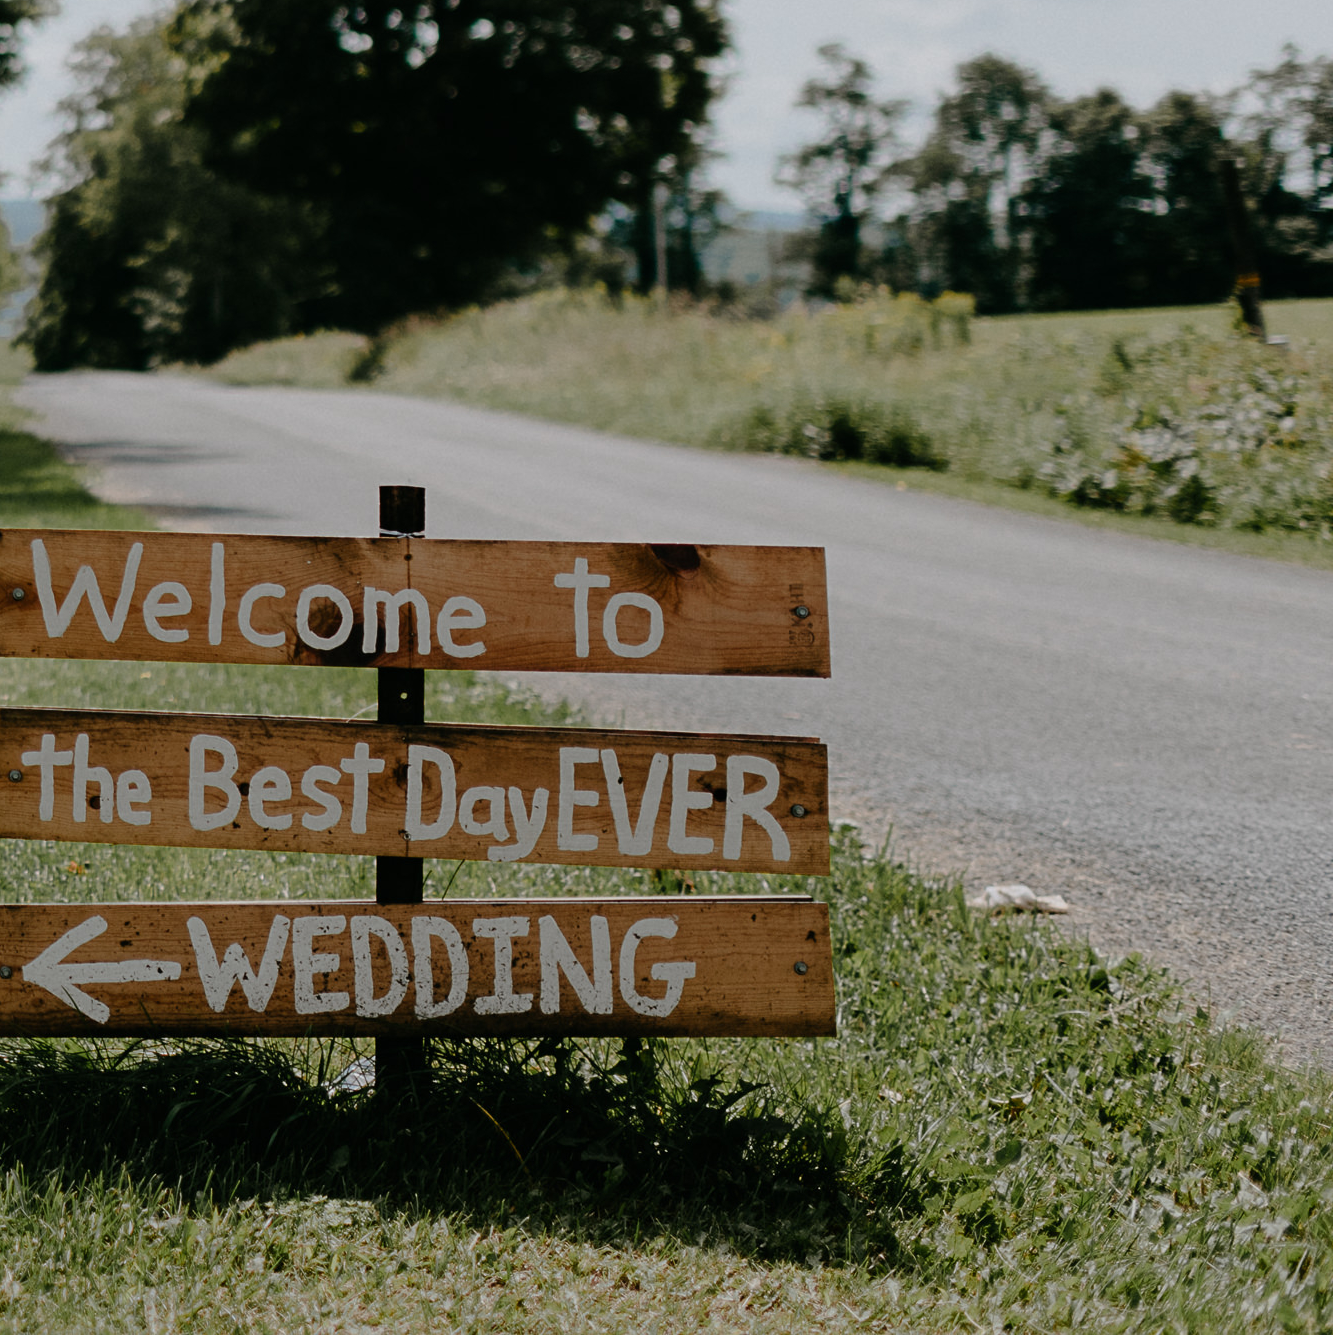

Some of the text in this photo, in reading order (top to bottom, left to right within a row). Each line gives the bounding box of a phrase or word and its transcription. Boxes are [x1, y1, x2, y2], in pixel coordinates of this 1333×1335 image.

[30, 538, 666, 659] Welcome to
[20, 732, 153, 826] the
[187, 733, 386, 835] Best
[186, 914, 697, 1020] WEDDING
